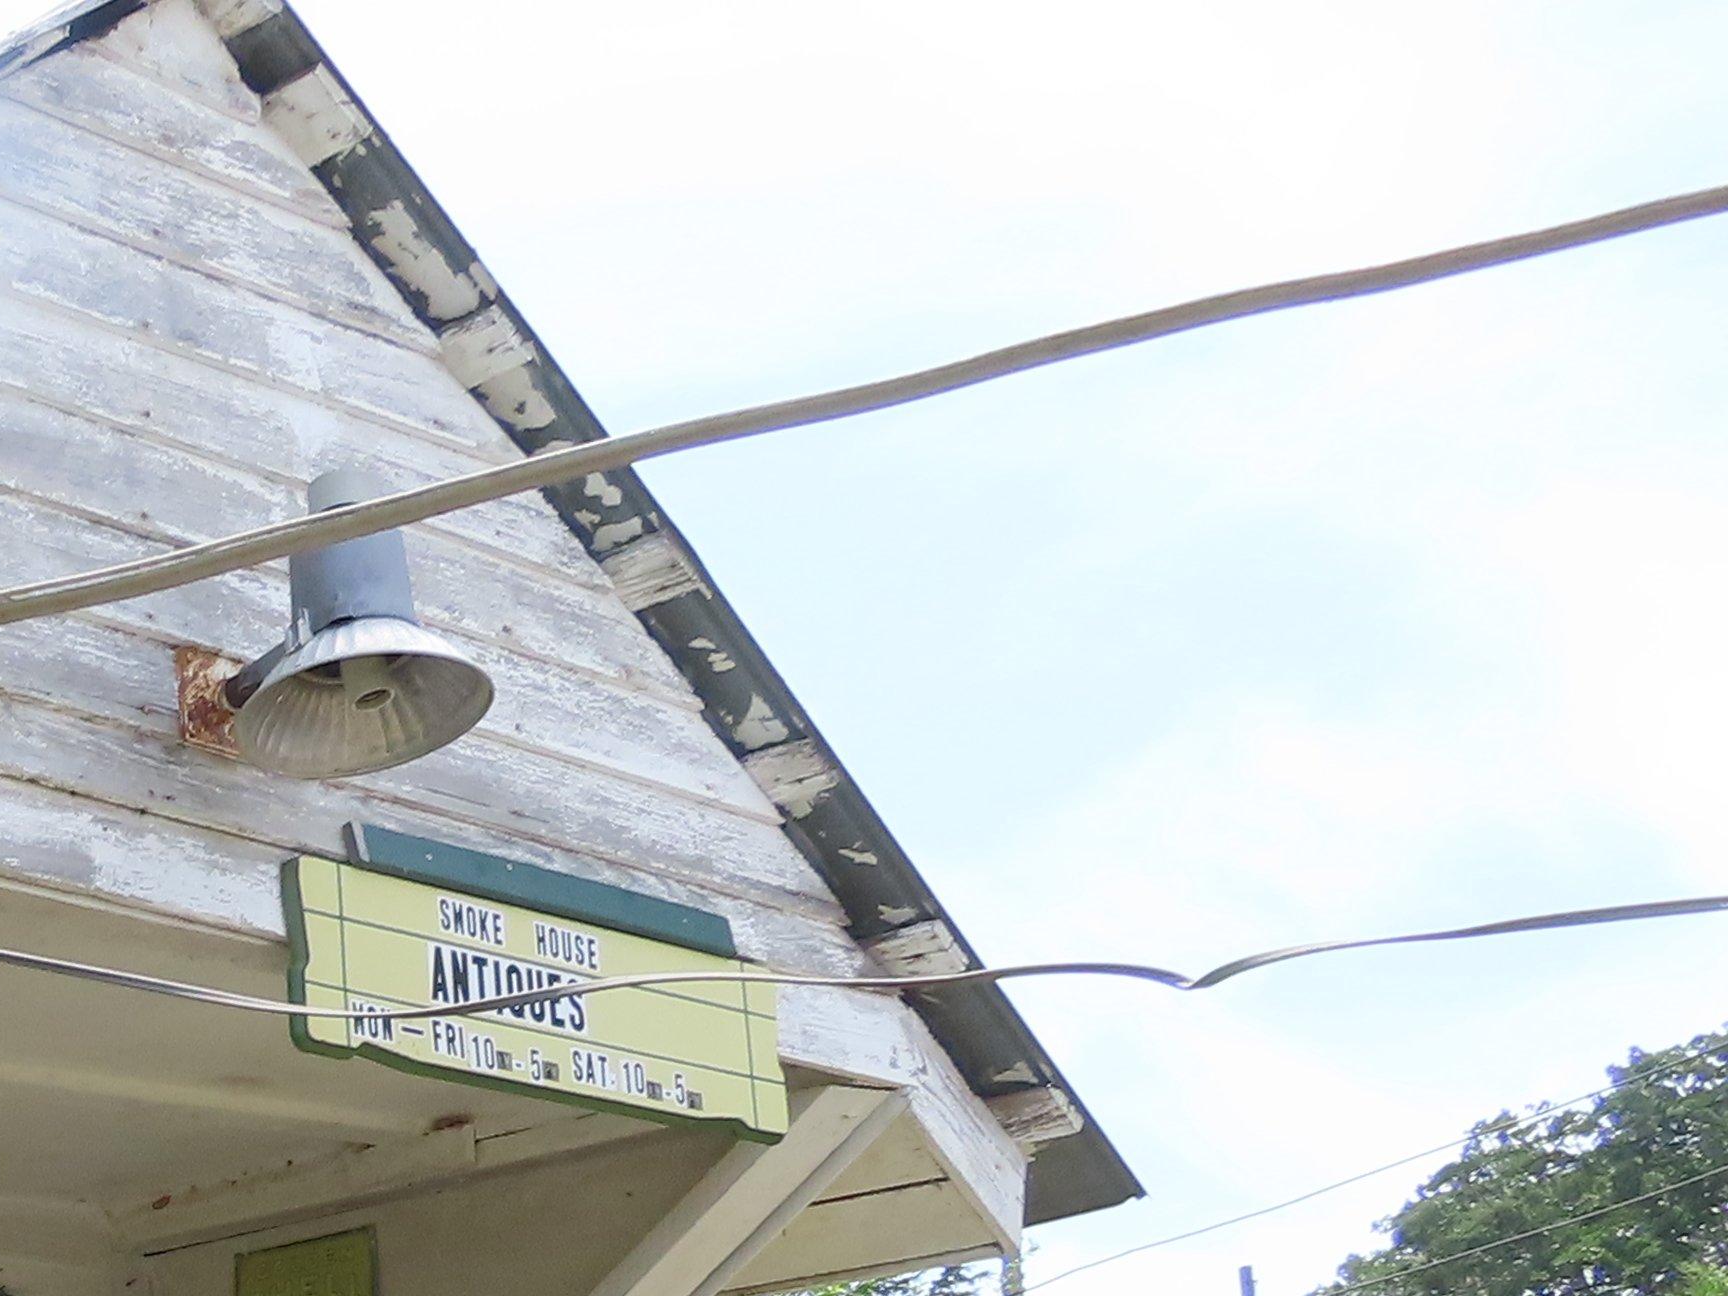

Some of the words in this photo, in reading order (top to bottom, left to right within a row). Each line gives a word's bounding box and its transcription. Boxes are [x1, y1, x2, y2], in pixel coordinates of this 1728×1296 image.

[439, 899, 504, 946] SMOKE
[535, 923, 599, 970] HOUSE
[431, 946, 586, 1032] ANTIQUES
[352, 1000, 394, 1042] MON
[431, 1018, 466, 1060] FRI
